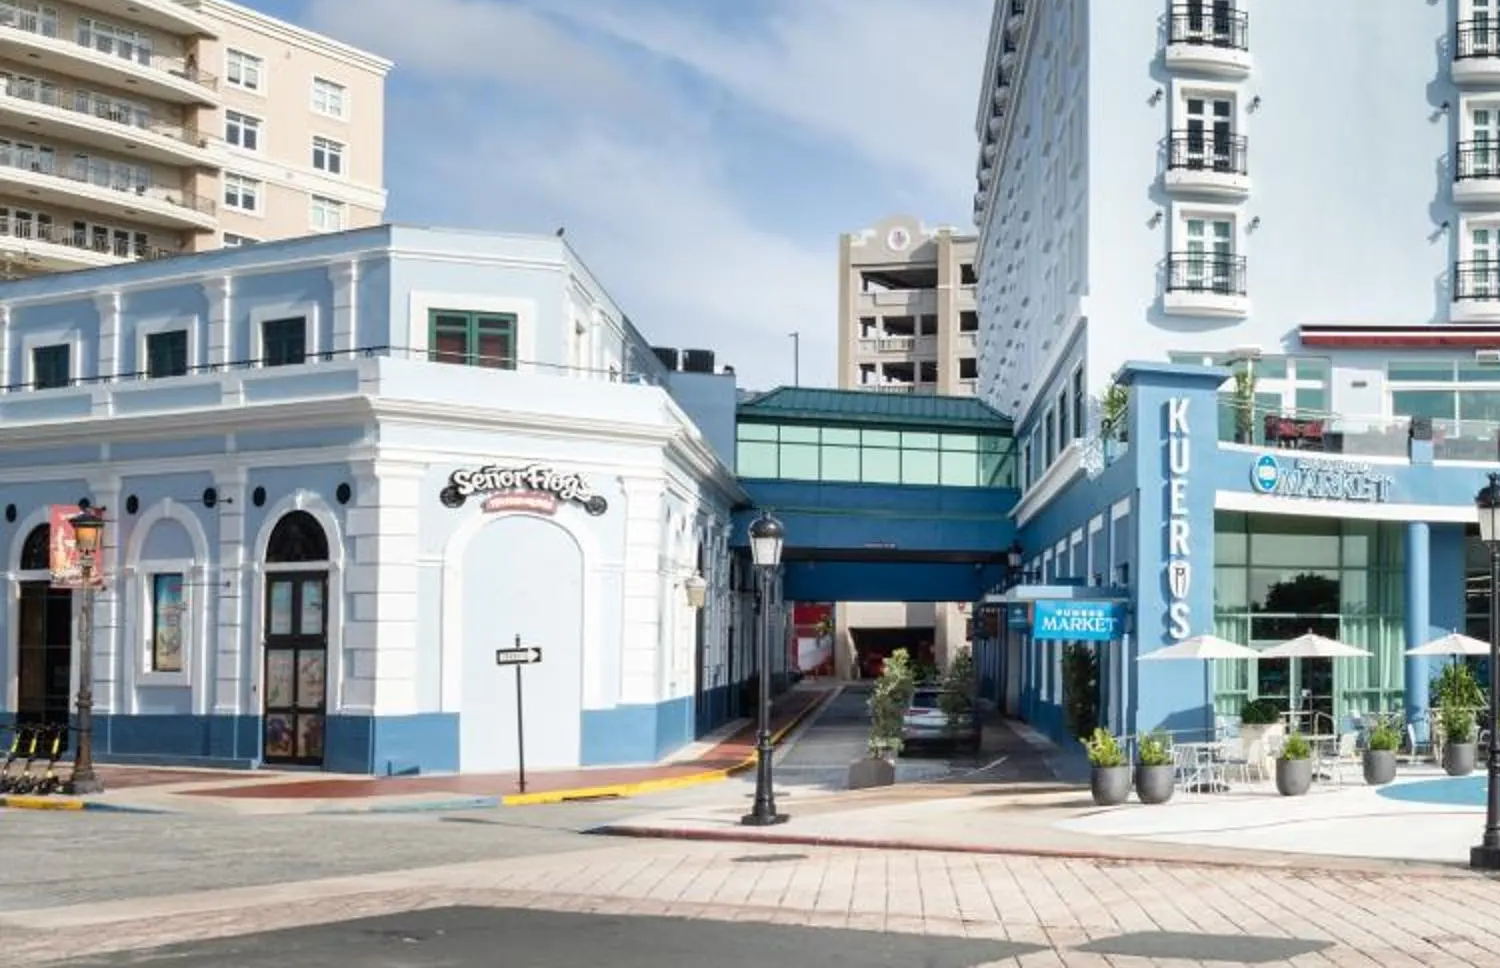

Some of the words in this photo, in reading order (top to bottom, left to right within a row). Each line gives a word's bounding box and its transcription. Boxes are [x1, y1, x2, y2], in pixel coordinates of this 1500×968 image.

[453, 464, 526, 495] Señor
[1278, 468, 1395, 503] MARKET
[1042, 616, 1117, 632] MARKET
